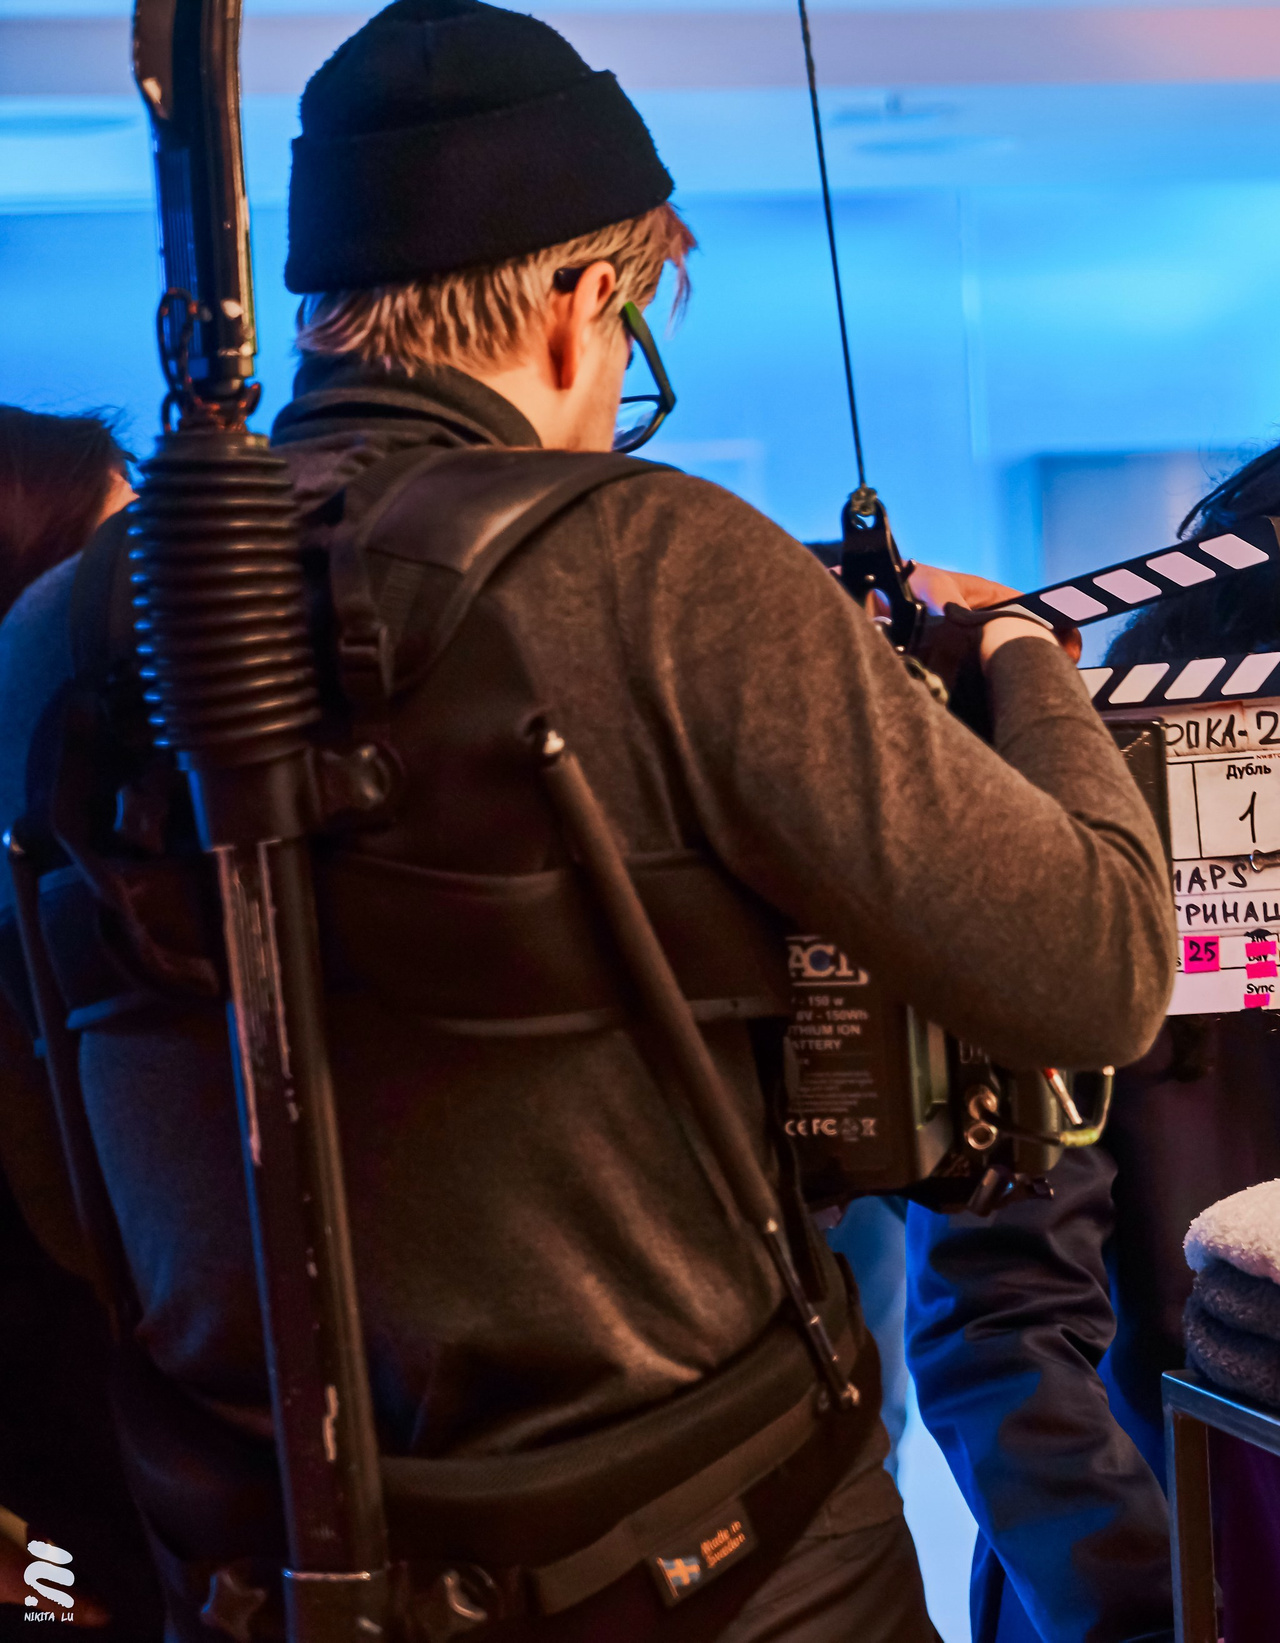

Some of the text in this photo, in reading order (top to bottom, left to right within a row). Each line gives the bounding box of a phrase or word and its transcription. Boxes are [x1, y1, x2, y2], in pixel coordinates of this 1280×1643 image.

[1226, 763, 1272, 780] Дубль
[1238, 791, 1257, 843] 1
[1188, 940, 1218, 962] 25
[1246, 983, 1275, 994] Sync
[836, 1024, 862, 1035] ION
[701, 1521, 742, 1556] Made in
[706, 1533, 746, 1568] Sweden
